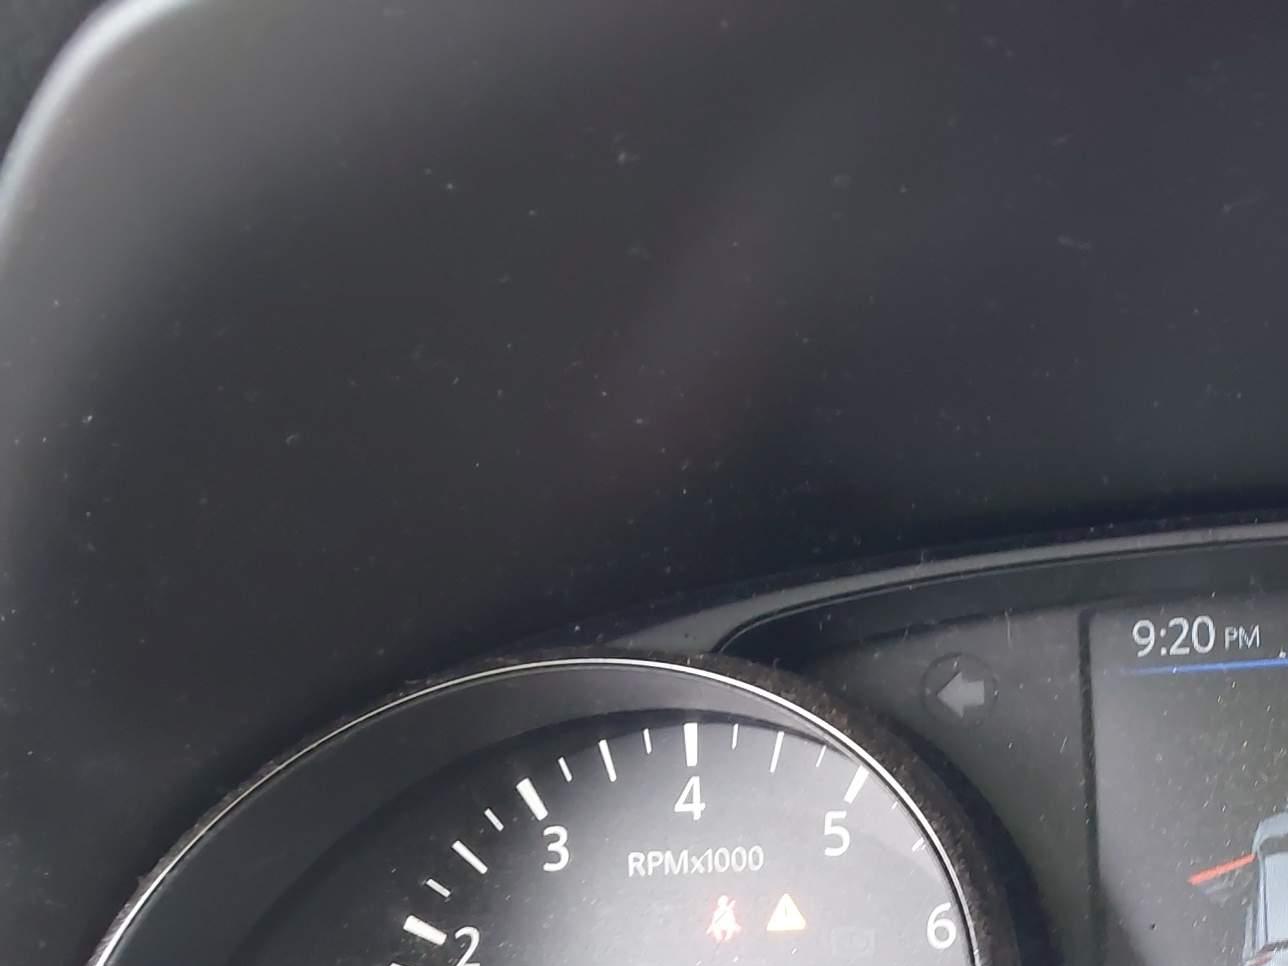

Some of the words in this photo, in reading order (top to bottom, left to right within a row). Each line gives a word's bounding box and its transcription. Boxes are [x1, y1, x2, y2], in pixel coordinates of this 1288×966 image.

[1132, 616, 1215, 657] 9:20
[1224, 624, 1260, 649] PM
[674, 776, 705, 820] 4
[542, 826, 570, 871] 3
[824, 811, 849, 856] 5
[628, 846, 764, 877] RPMx1000
[926, 902, 957, 950] 6
